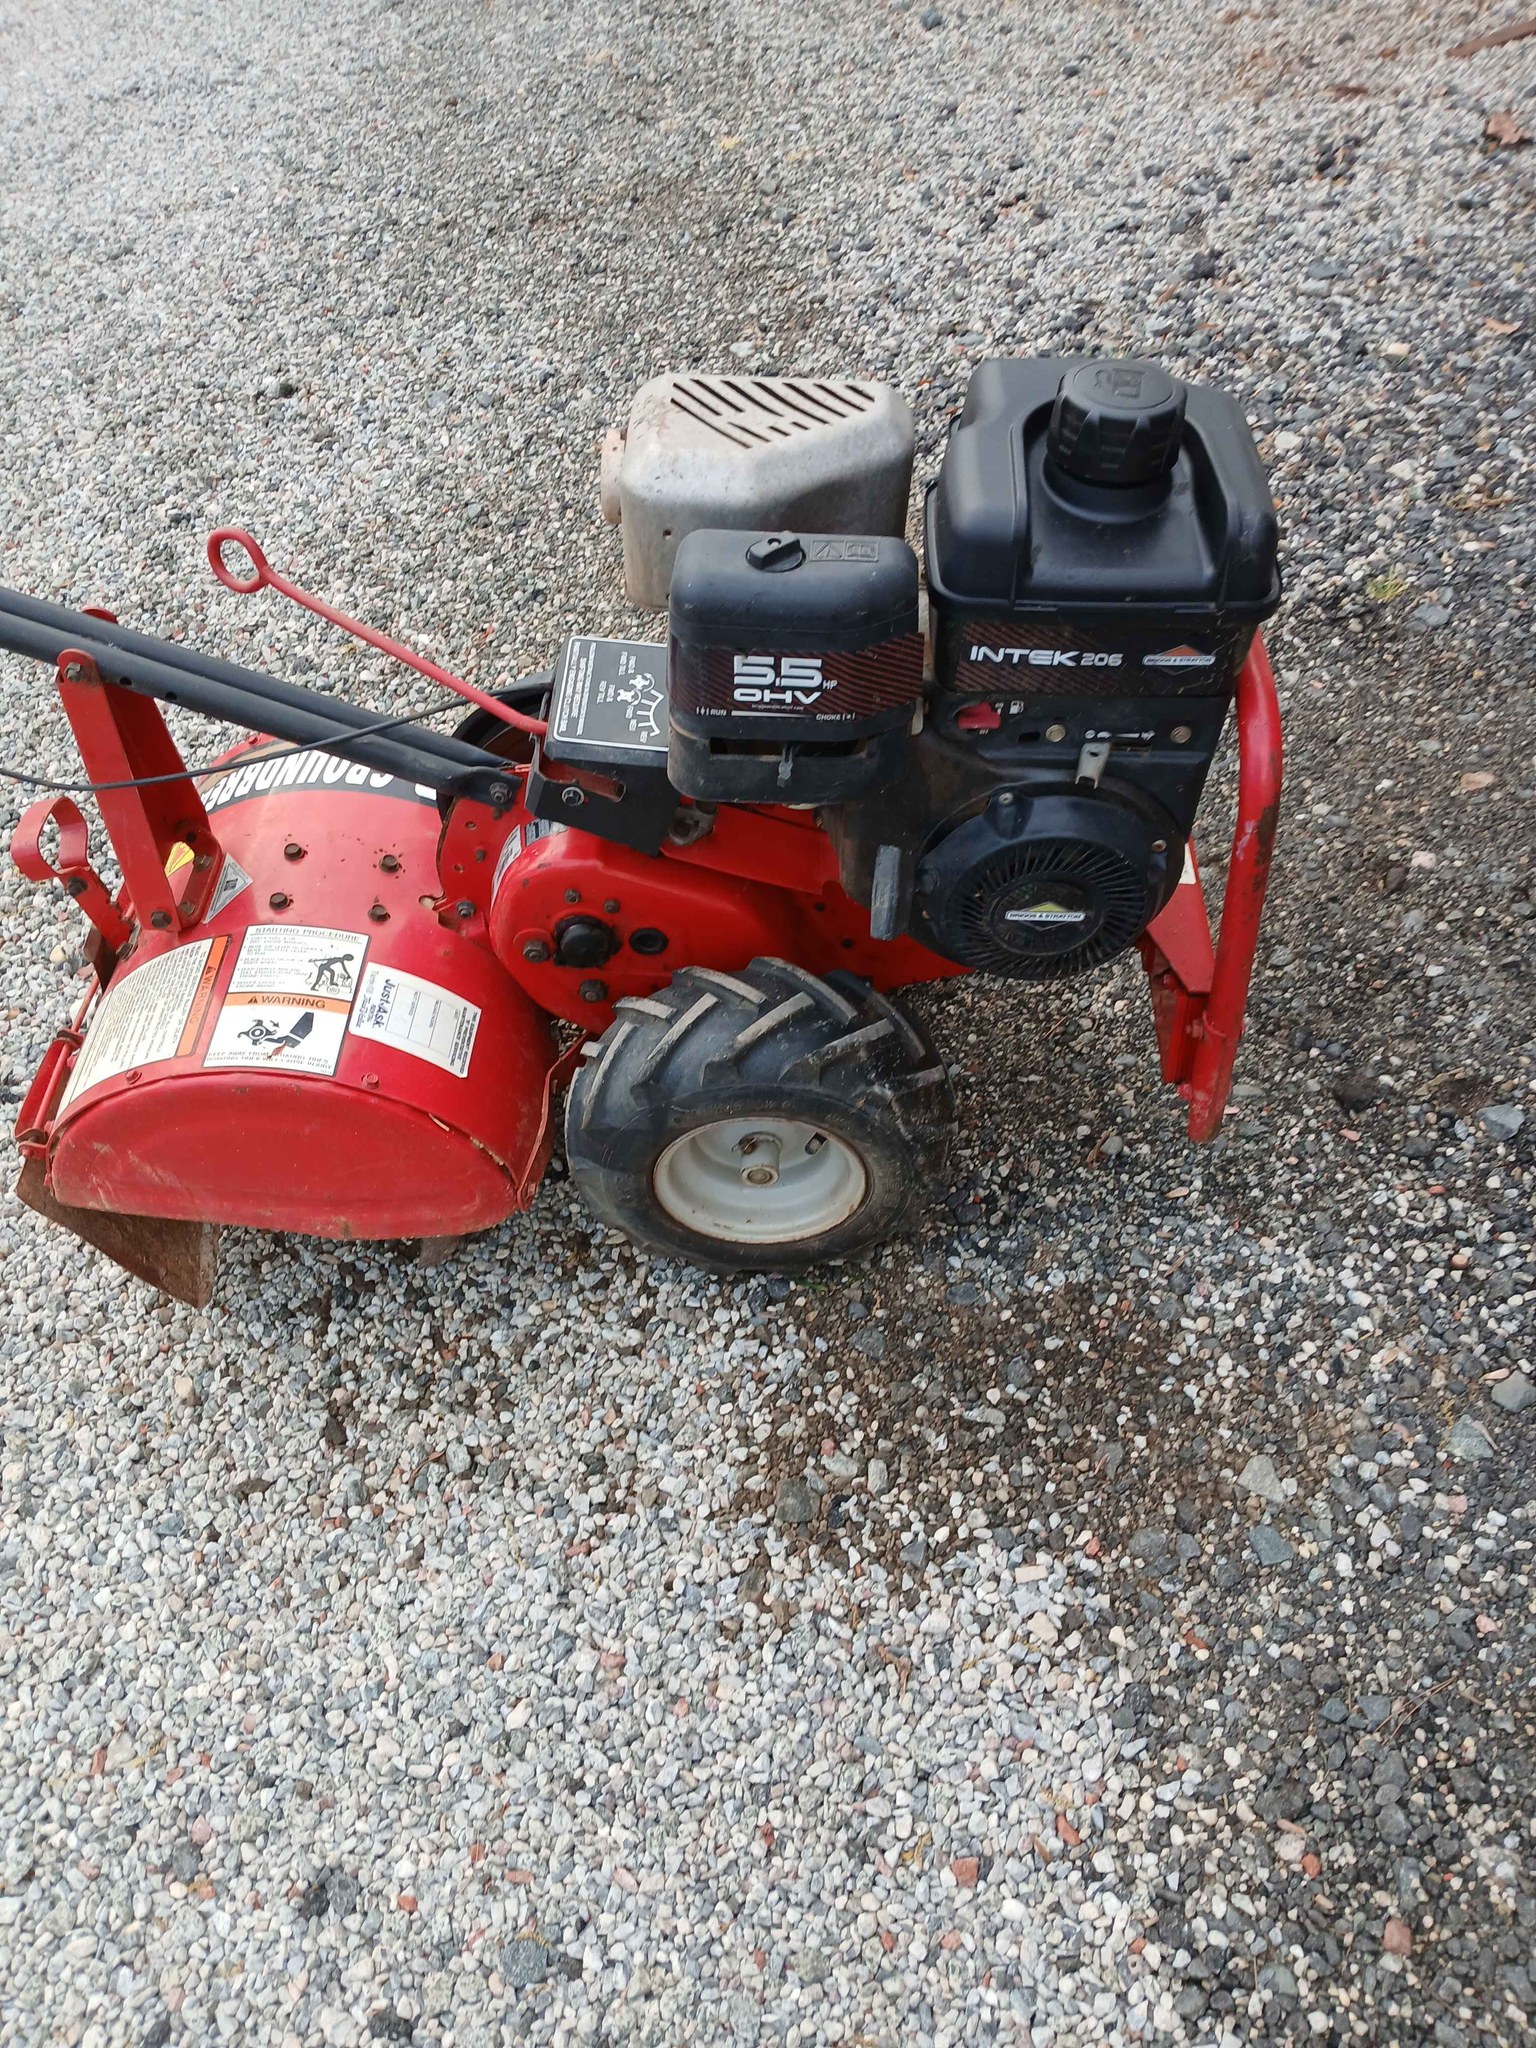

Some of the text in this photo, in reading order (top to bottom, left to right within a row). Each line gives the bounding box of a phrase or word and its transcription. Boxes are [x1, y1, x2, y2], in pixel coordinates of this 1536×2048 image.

[969, 645, 1123, 667] INTEK 206
[733, 655, 838, 690] 5.5 HP
[733, 688, 823, 705] OHV
[710, 709, 727, 717] RUN
[816, 713, 841, 721] CHOKE
[201, 750, 395, 813] ROUNDBRE
[303, 928, 360, 941] PROCEDURE
[189, 974, 214, 1024] WARNING
[261, 995, 326, 1009] WARNING
[373, 978, 396, 1028] Just Ask
